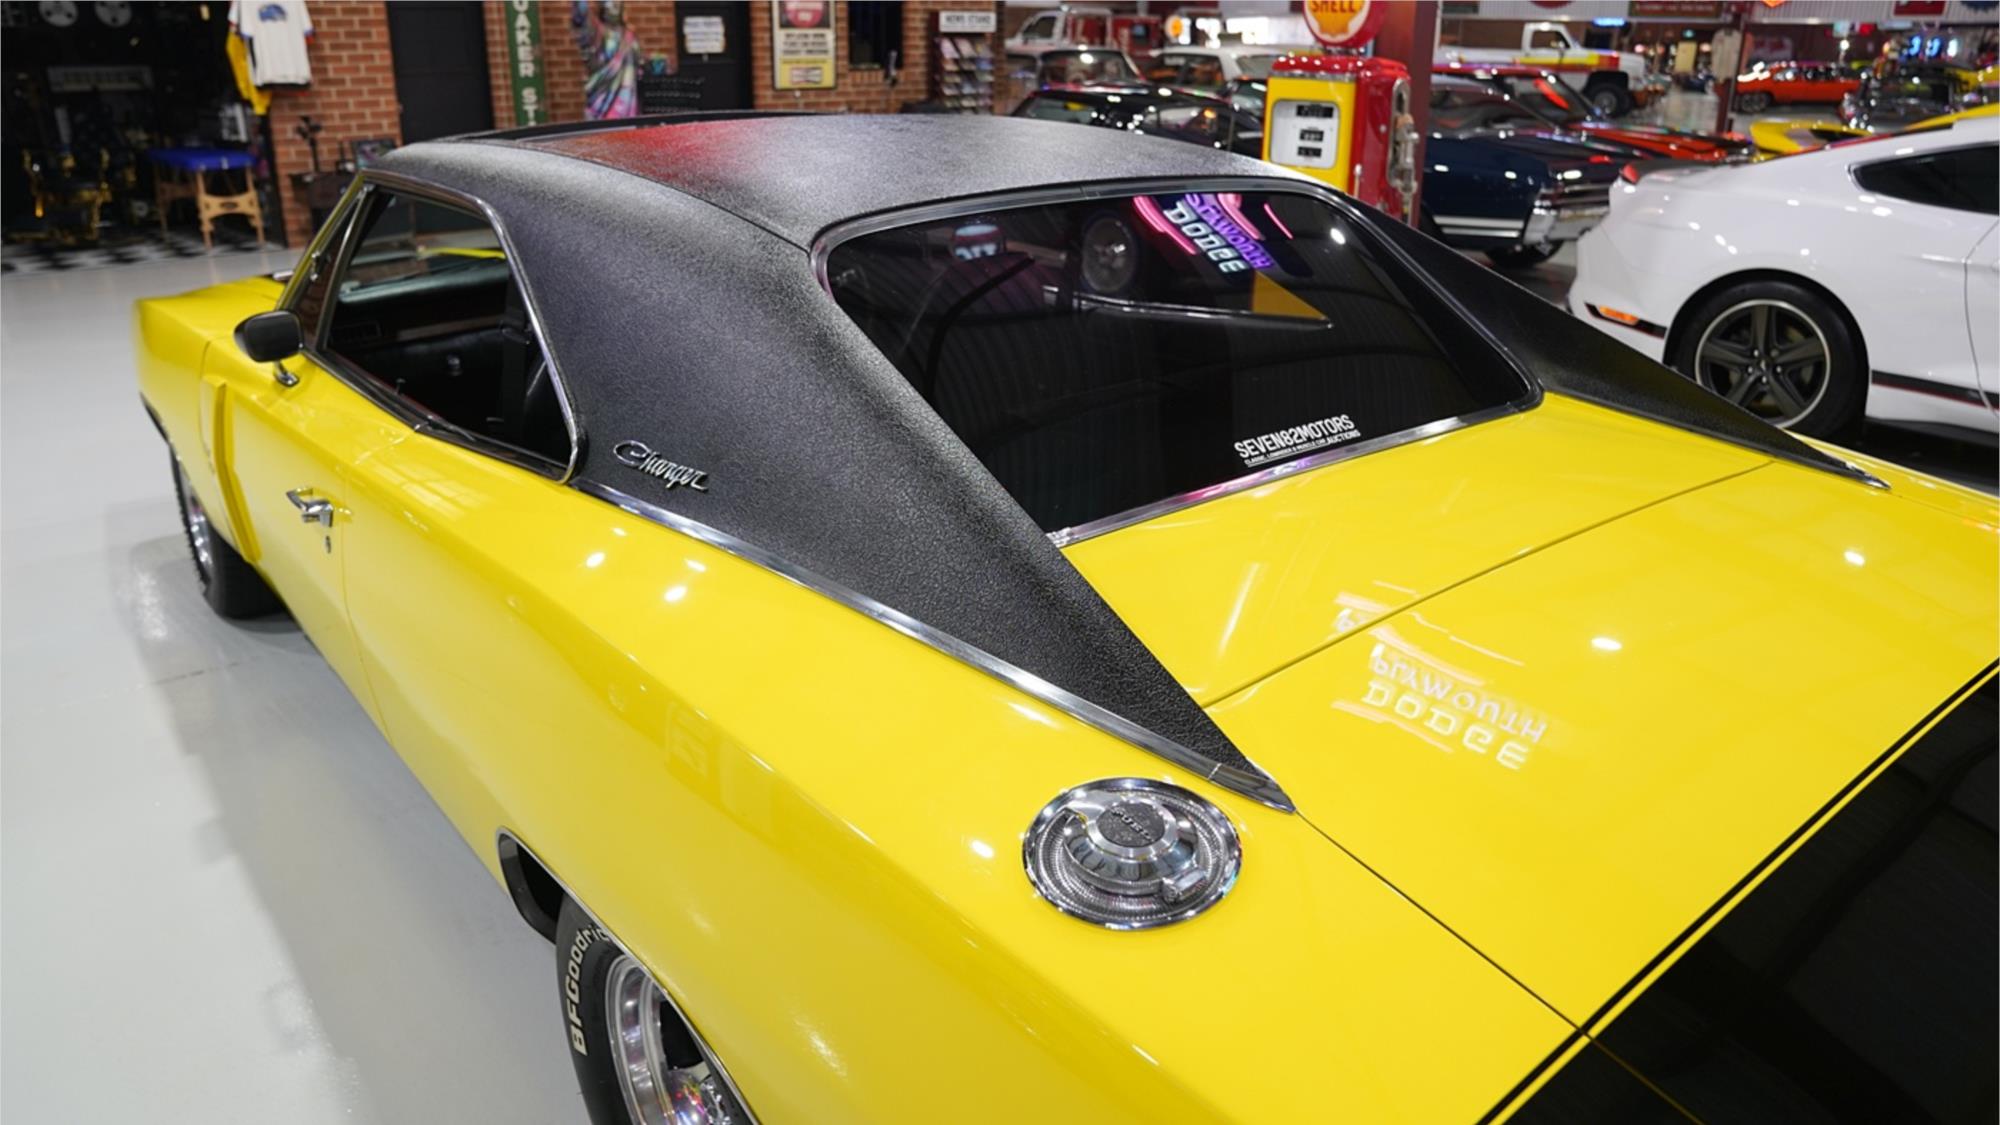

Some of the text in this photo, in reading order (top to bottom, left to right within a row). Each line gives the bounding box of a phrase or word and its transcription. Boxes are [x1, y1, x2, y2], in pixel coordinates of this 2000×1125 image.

[1312, 0, 1355, 13] SHELL
[521, 87, 538, 126] ST
[1234, 414, 1355, 459] SEVEN82MOTORS
[1326, 429, 1361, 445] AUCTIONS
[613, 440, 708, 490] Charger
